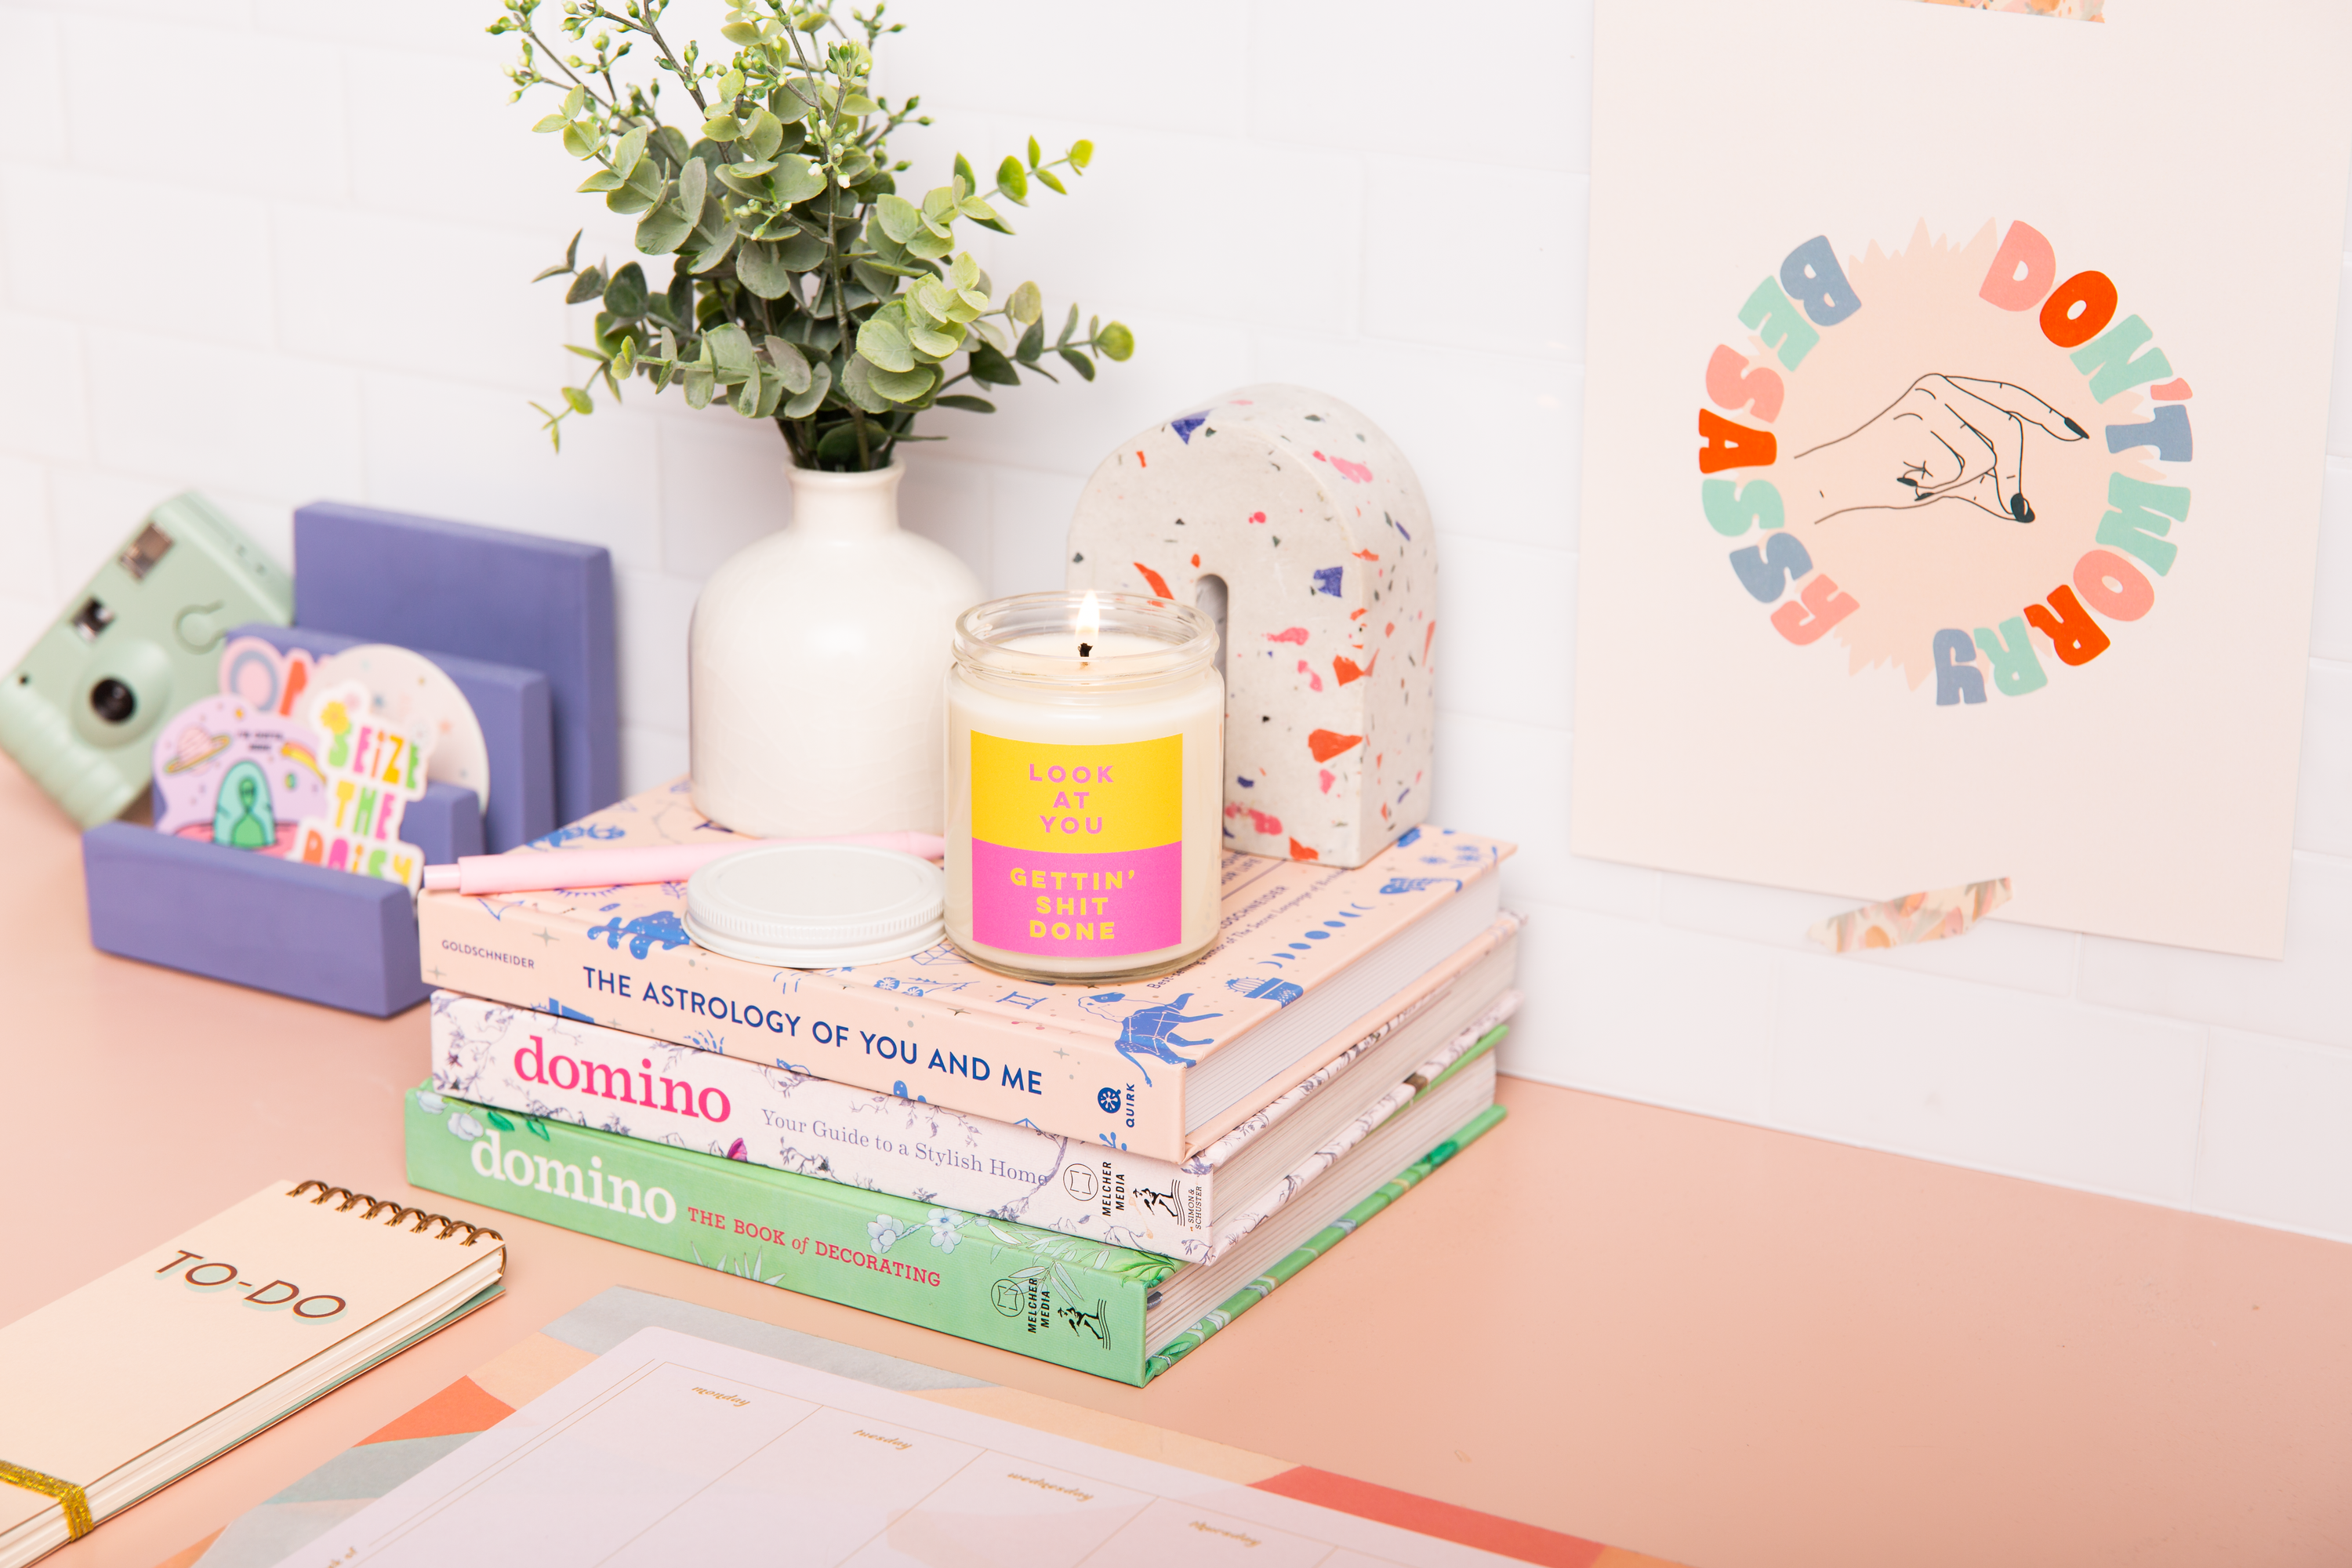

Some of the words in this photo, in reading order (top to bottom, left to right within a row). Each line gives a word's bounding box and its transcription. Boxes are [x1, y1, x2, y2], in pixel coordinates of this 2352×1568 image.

[1737, 235, 1862, 372] BE
[1979, 220, 2193, 463] DON'T
[1699, 344, 1860, 645] SASSY
[1933, 471, 2191, 706] WORRY
[1029, 763, 1114, 784] LOOK
[336, 780, 395, 840] THE
[1039, 815, 1103, 835] YOU
[1052, 791, 1090, 809] AT
[1010, 867, 1135, 891] GETTIN'
[1029, 919, 1115, 940] DONE
[1036, 895, 1109, 916] SHIT
[441, 939, 535, 969] GOLDSCHNEIDER
[583, 966, 631, 998] THE
[643, 982, 800, 1036] ASTROLOGY
[812, 1021, 848, 1048] OF
[861, 1032, 917, 1064] YOU
[928, 1048, 990, 1080] AND
[1001, 1065, 1043, 1095] ME
[514, 1035, 731, 1123] domino
[1126, 1083, 1135, 1127] QUIRK
[761, 1109, 806, 1134] Your
[812, 1120, 869, 1147] Guide
[876, 1134, 893, 1152] to
[898, 1143, 909, 1156] a
[916, 1142, 983, 1172] Stylish
[989, 1158, 1048, 1186] Home
[471, 1128, 677, 1225] domino
[1102, 1161, 1112, 1217] MELCHER
[1115, 1174, 1125, 1211] MEDIA
[688, 1207, 725, 1229] THE
[734, 1218, 786, 1246] BOOK
[792, 1237, 810, 1255] of
[815, 1240, 941, 1287] DECORATING
[155, 1249, 347, 1323] TO-DO
[1028, 1278, 1037, 1334] MELCHER
[1040, 1290, 1051, 1328] MEDIA
[691, 1385, 751, 1408] monday
[852, 1428, 913, 1450] tuesday
[1007, 1471, 1094, 1502] wednesday
